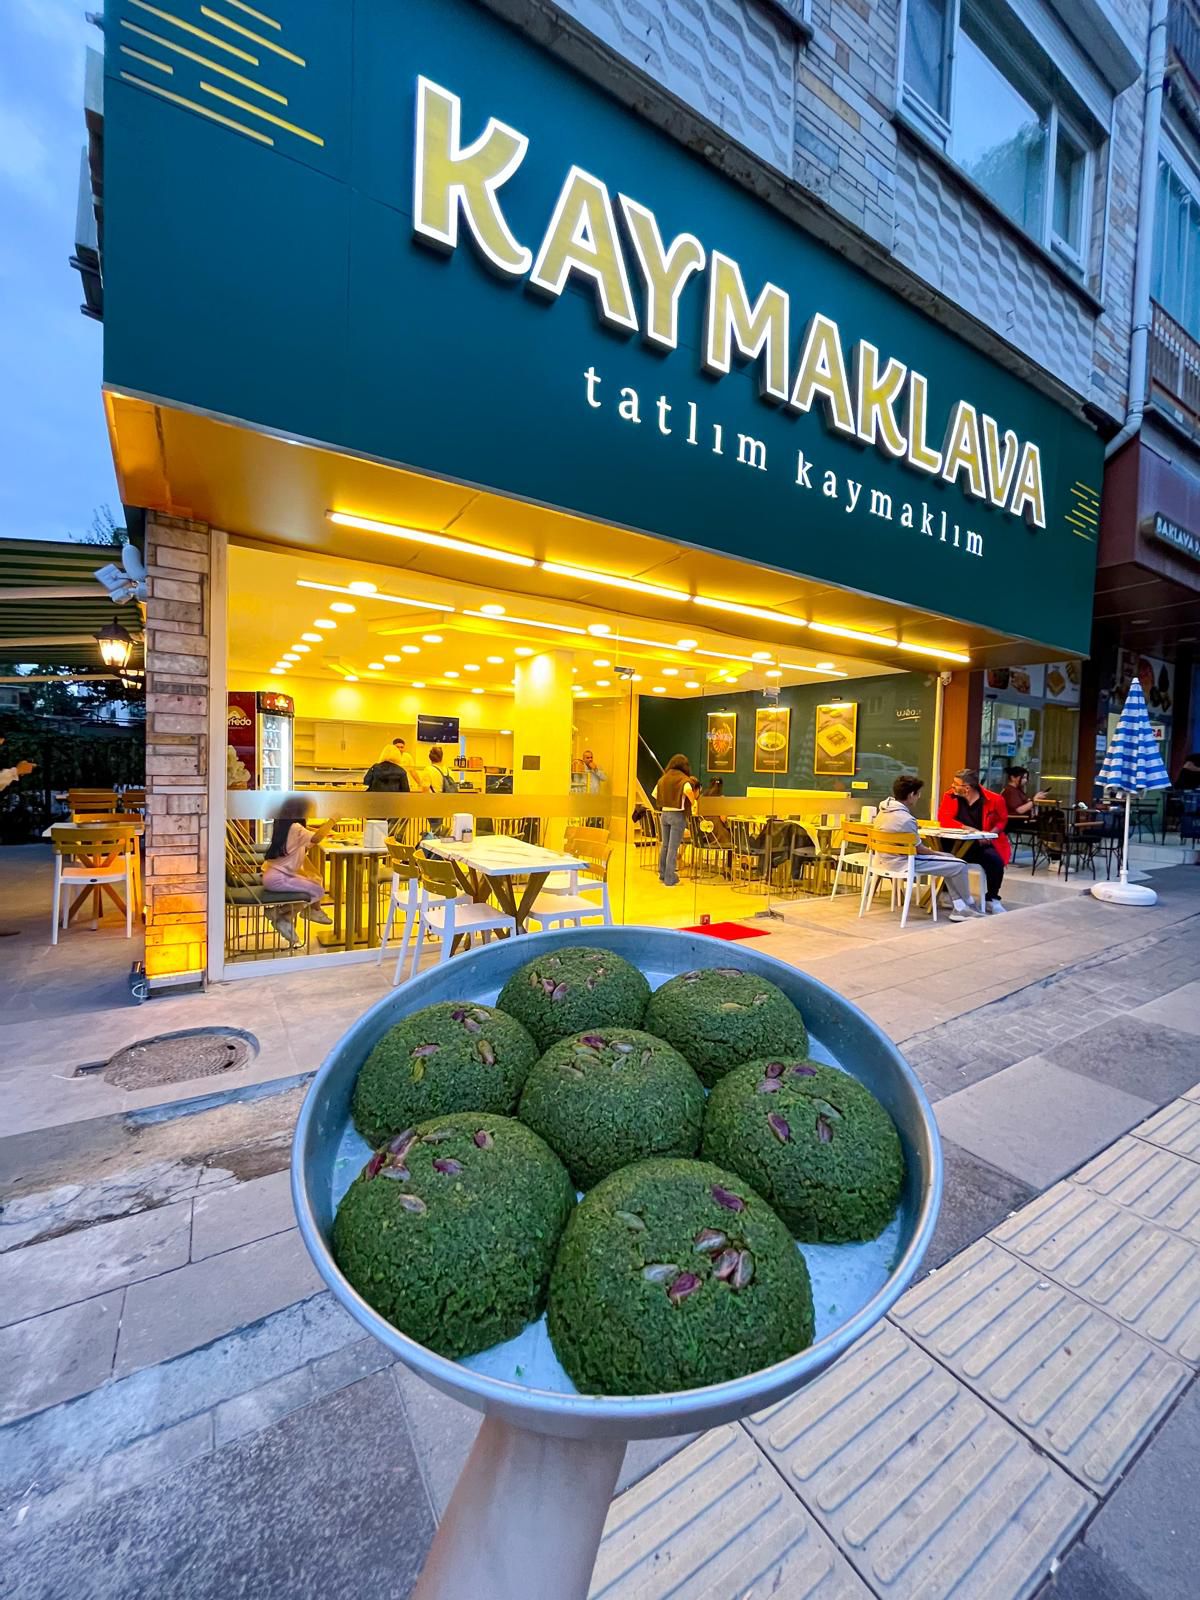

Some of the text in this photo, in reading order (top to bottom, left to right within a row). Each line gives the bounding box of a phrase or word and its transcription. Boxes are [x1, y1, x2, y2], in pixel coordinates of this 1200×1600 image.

[413, 74, 1047, 530] KAYMAKLAVA
[583, 366, 984, 557] tatlım kaymaklım
[1156, 516, 1194, 551] BAKLAVA
